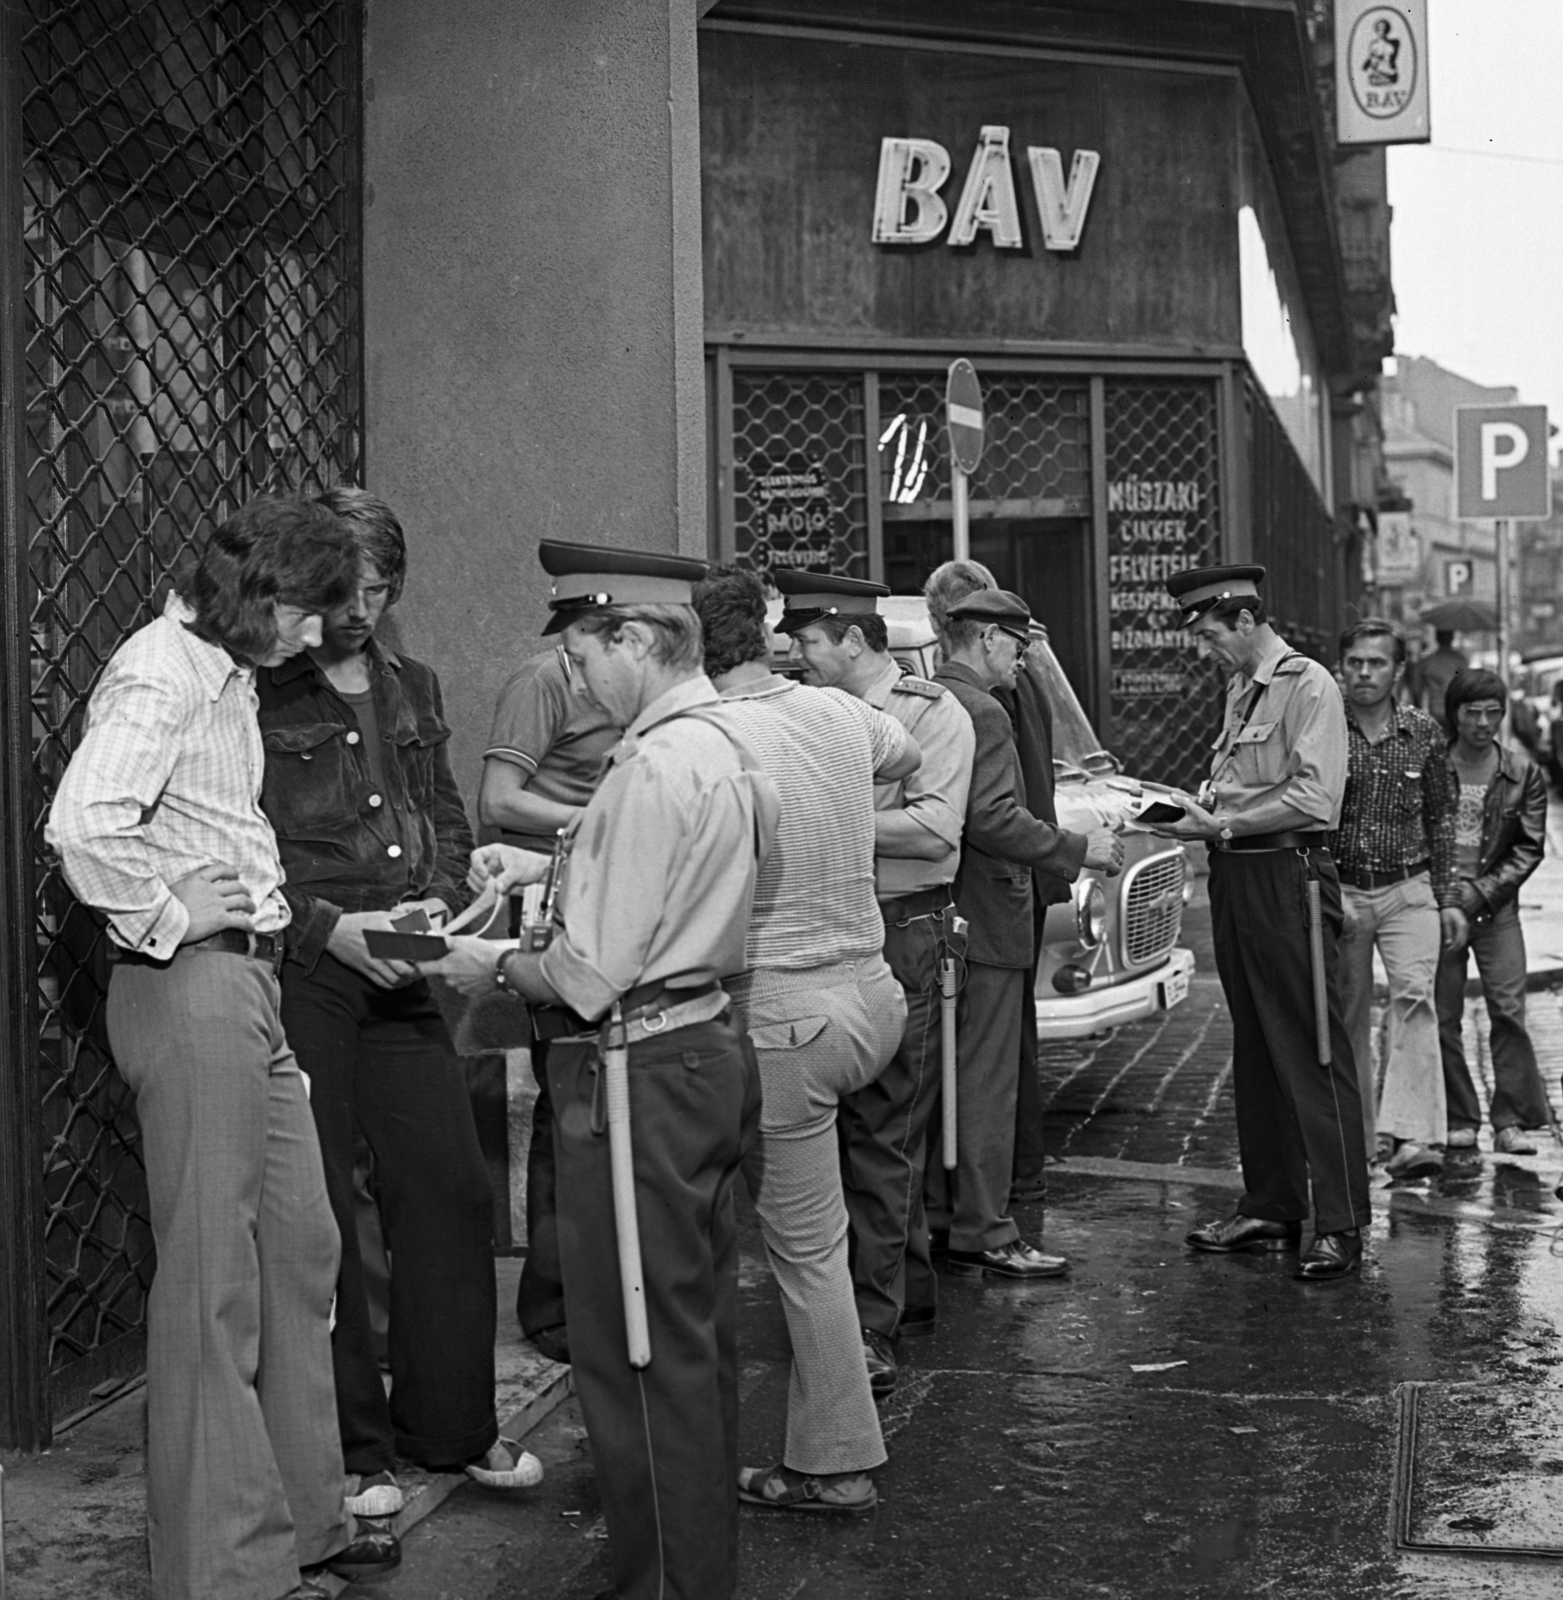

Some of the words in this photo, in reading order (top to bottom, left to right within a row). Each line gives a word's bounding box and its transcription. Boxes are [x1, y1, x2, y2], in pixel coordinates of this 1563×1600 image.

[871, 125, 1100, 250] BÁV
[1481, 422, 1529, 500] P
[1121, 519, 1187, 541] CIKKEK
[1450, 563, 1469, 595] P
